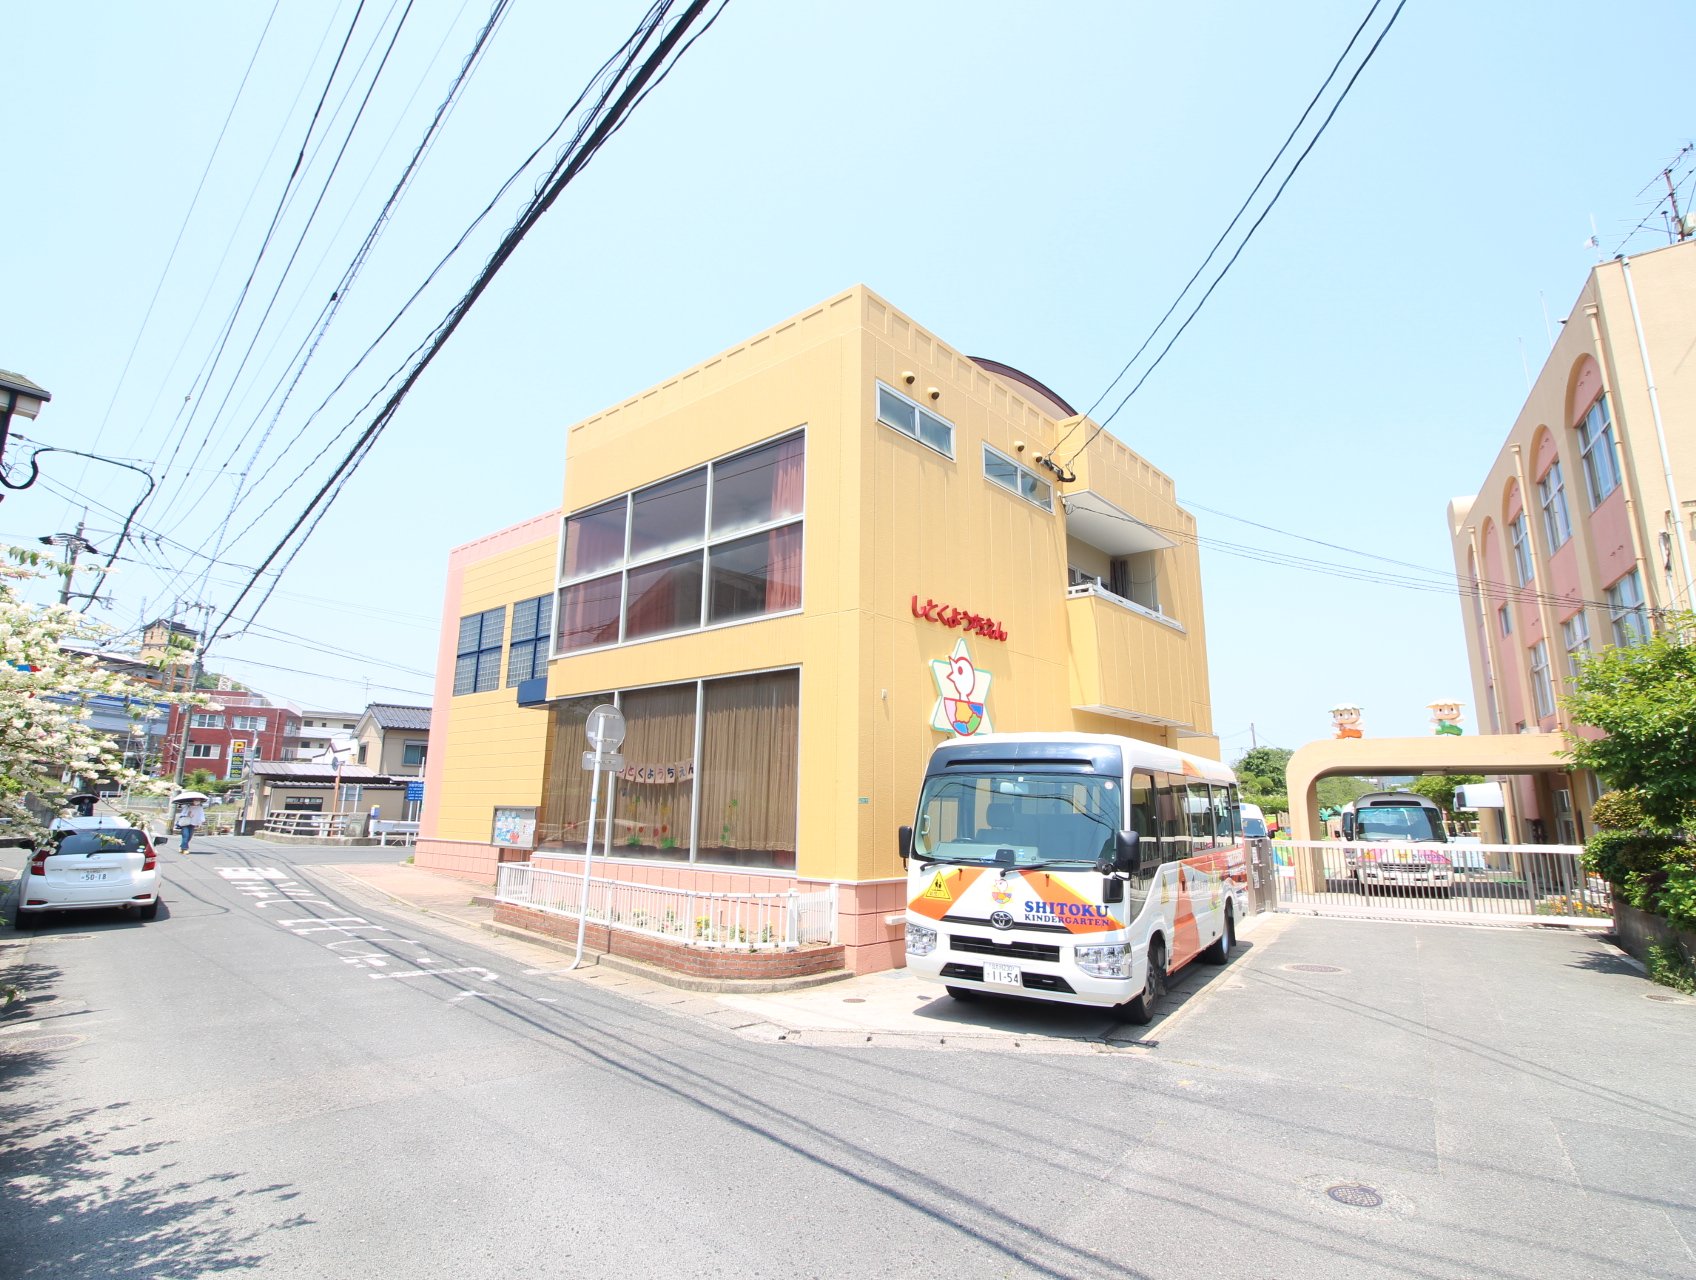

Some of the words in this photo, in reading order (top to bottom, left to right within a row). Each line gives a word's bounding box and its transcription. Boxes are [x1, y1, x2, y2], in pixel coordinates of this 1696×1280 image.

[911, 594, 1008, 641] しとくようちえん
[619, 763, 694, 779] とくようちえん
[1024, 900, 1109, 917] SHITOKU
[1024, 913, 1110, 927] KINDERGARTEN
[993, 970, 1019, 983] 11-54
